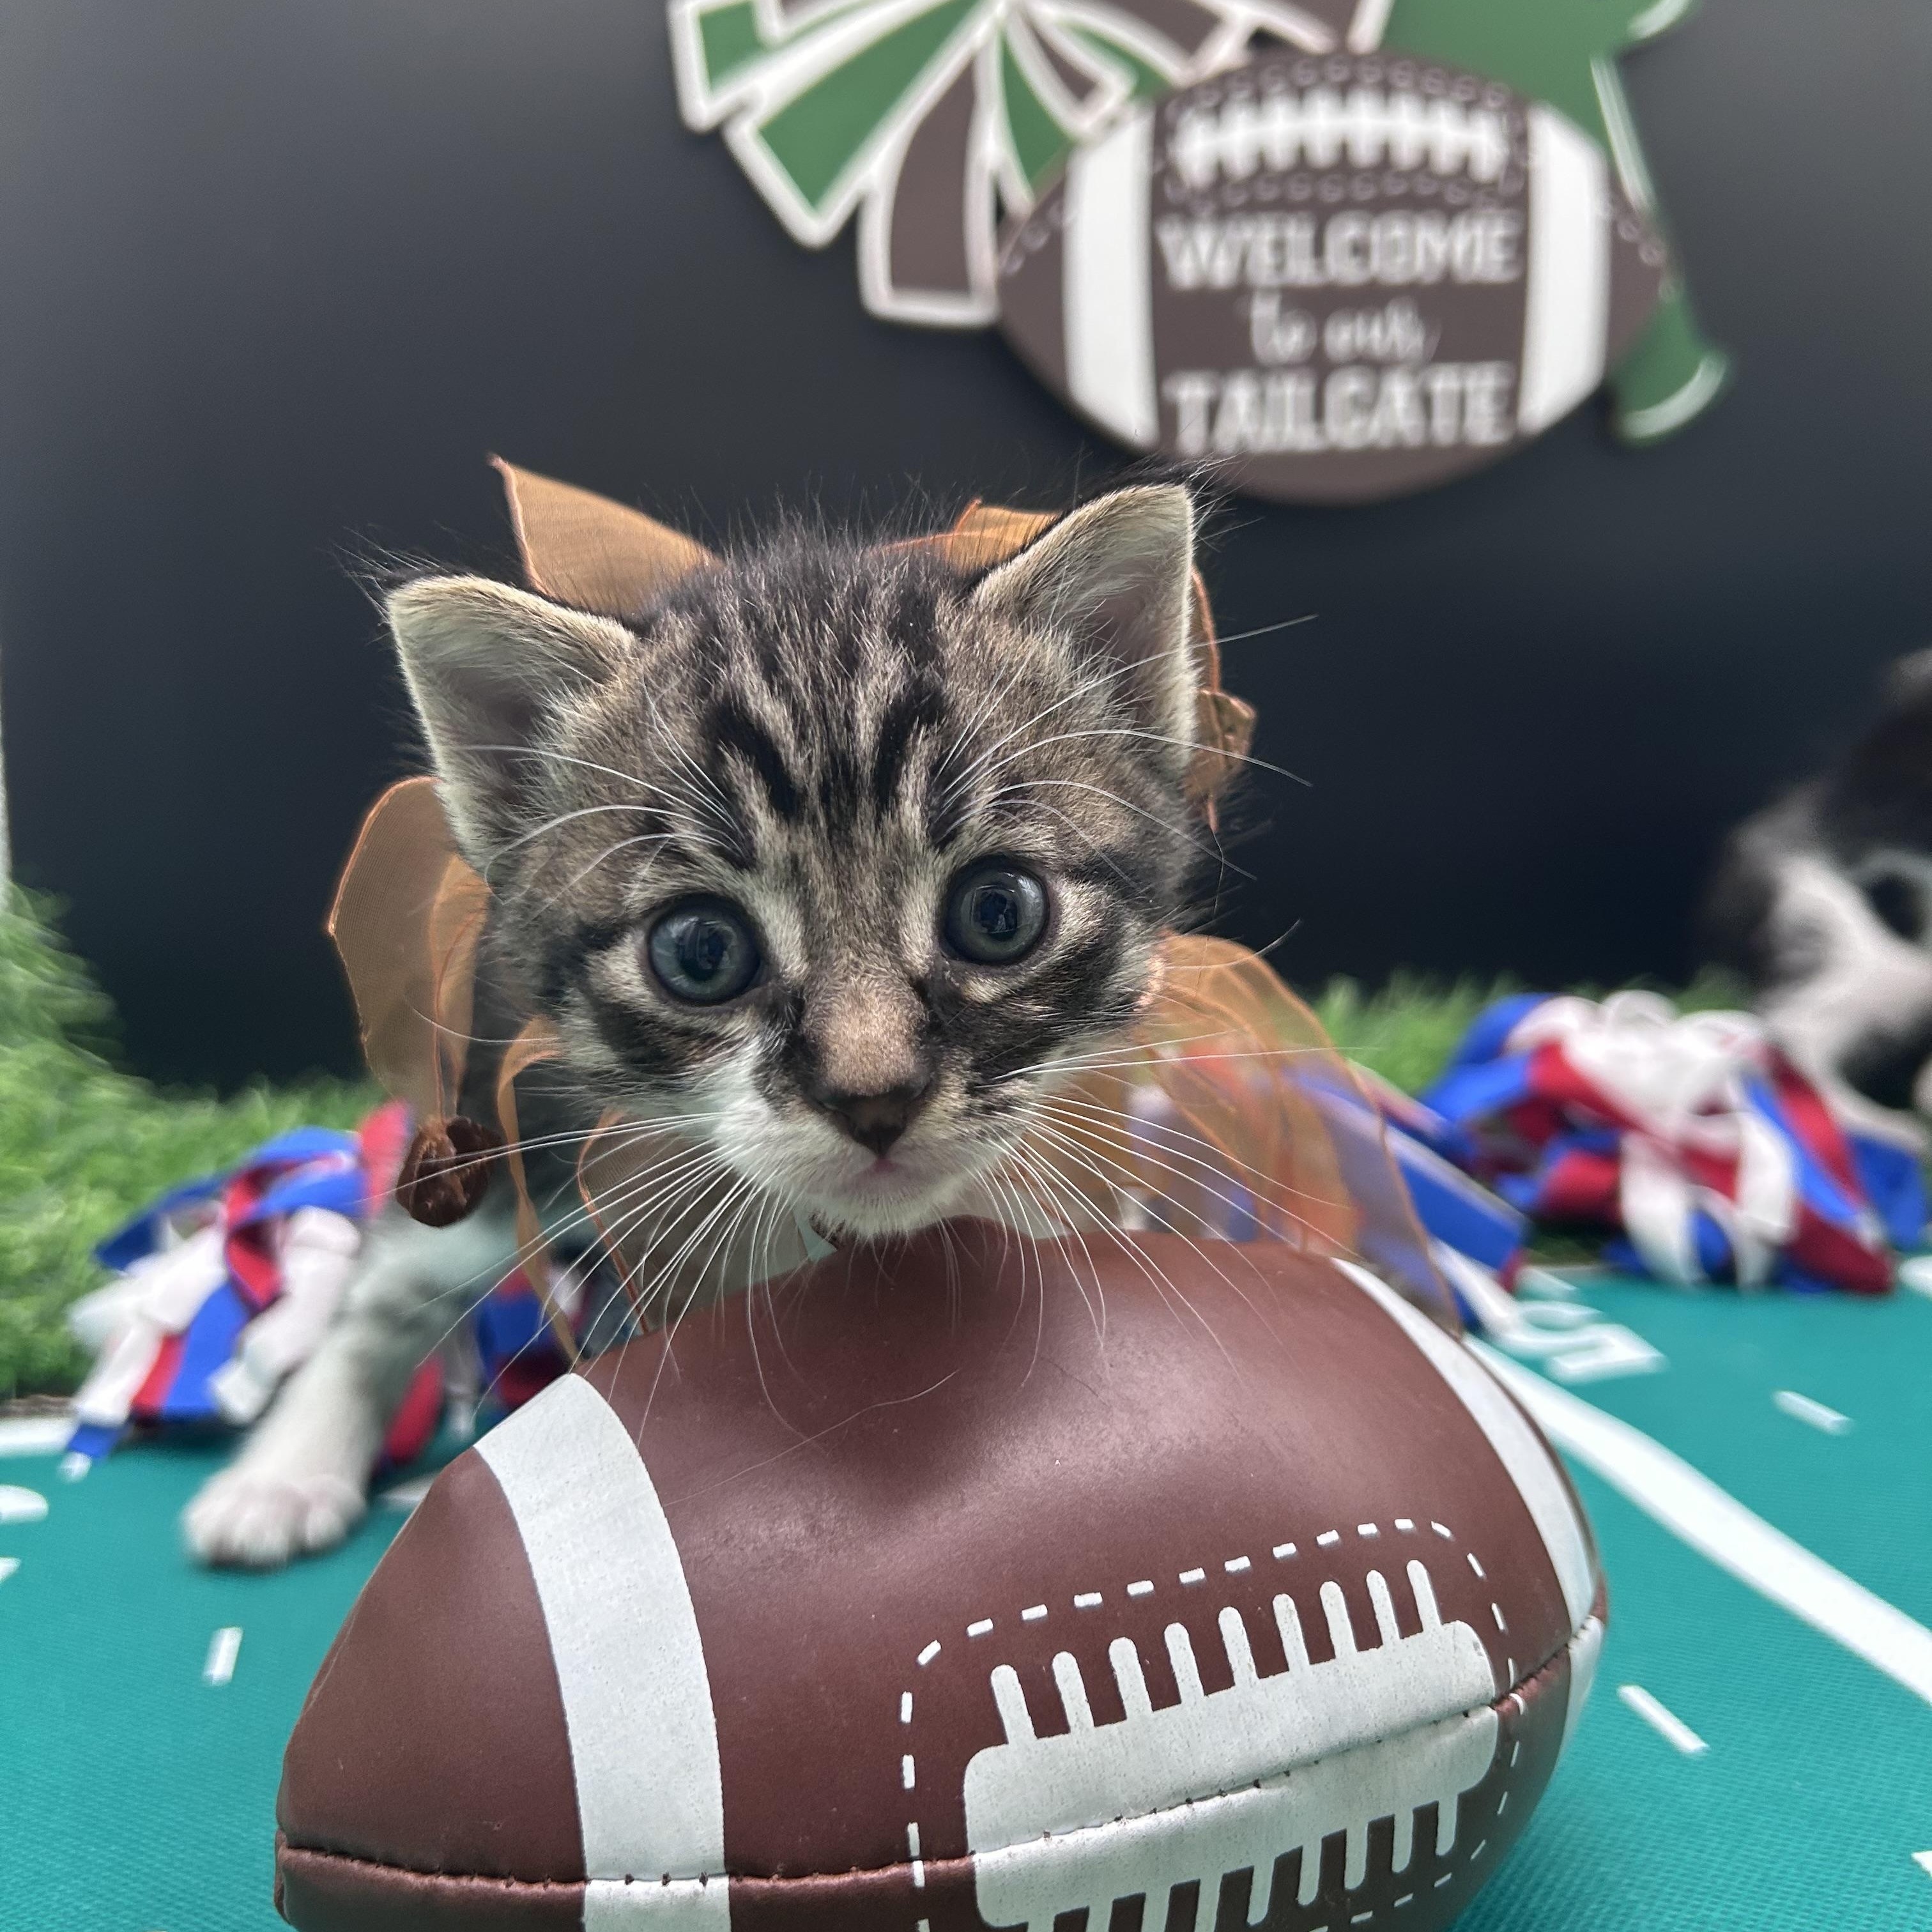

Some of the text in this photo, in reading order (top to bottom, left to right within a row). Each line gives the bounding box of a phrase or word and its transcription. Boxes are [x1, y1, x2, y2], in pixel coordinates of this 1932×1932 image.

[1158, 211, 1523, 290] WELCOME
[1239, 288, 1317, 365] to
[1162, 360, 1514, 456] TAILGATE
